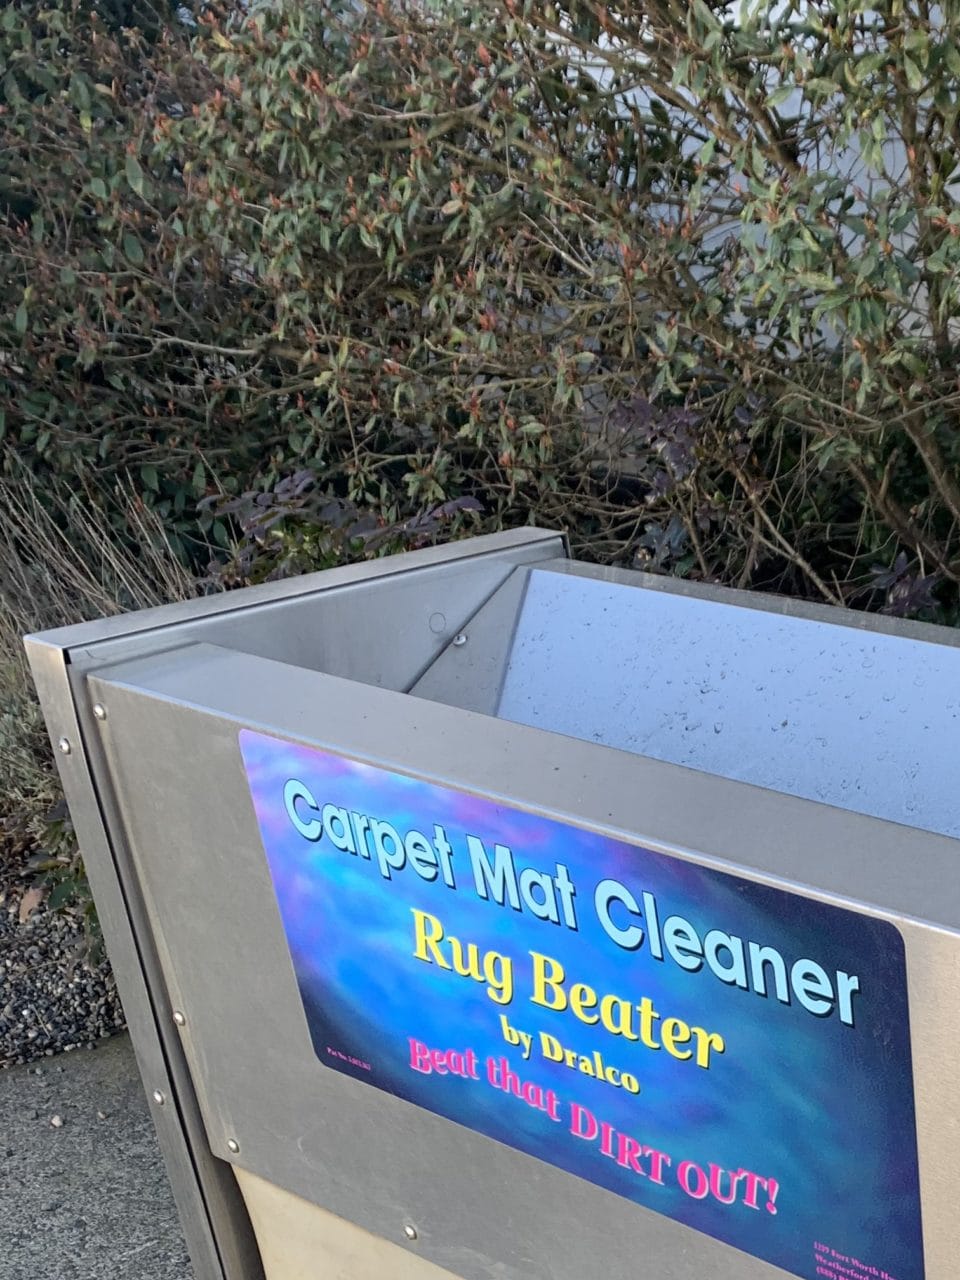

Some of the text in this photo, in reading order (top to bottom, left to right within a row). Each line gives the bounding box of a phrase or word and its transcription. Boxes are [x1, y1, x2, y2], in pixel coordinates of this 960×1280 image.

[283, 779, 860, 1027] Carpet Mat Cleaner
[411, 907, 725, 1069] Rug Beater
[499, 1014, 640, 1095] by Dralco
[407, 1037, 479, 1081] Beat
[487, 1057, 559, 1121] that
[570, 1102, 671, 1184] DIRT
[677, 1161, 780, 1215] OUT!
[851, 1258, 879, 1277] Worth
